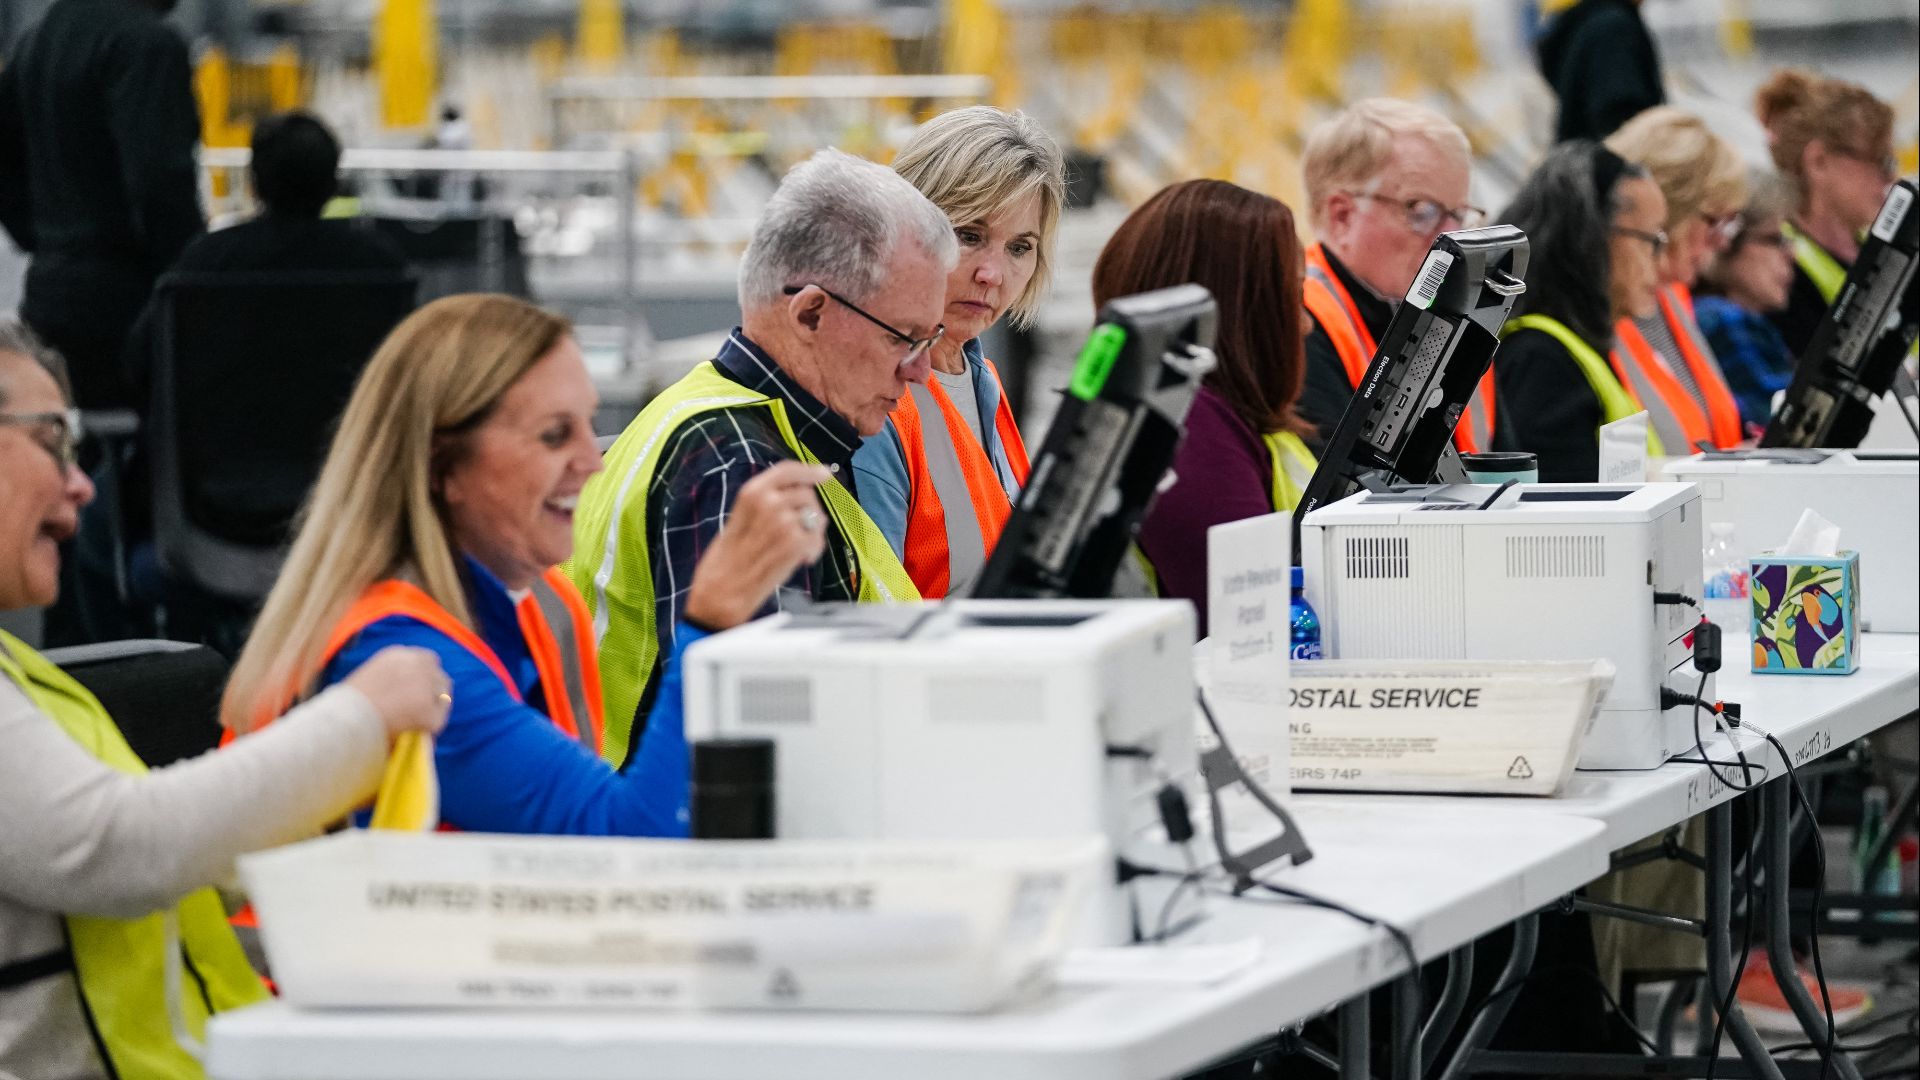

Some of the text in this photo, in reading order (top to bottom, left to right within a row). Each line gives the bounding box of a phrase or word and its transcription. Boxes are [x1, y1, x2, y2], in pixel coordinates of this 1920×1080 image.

[1364, 355, 1390, 399] Election Data
[1369, 687, 1481, 708] SERVICE
[1330, 768, 1362, 780] 74P
[369, 880, 876, 914] UNITED STATES POSTAL SERVICE
